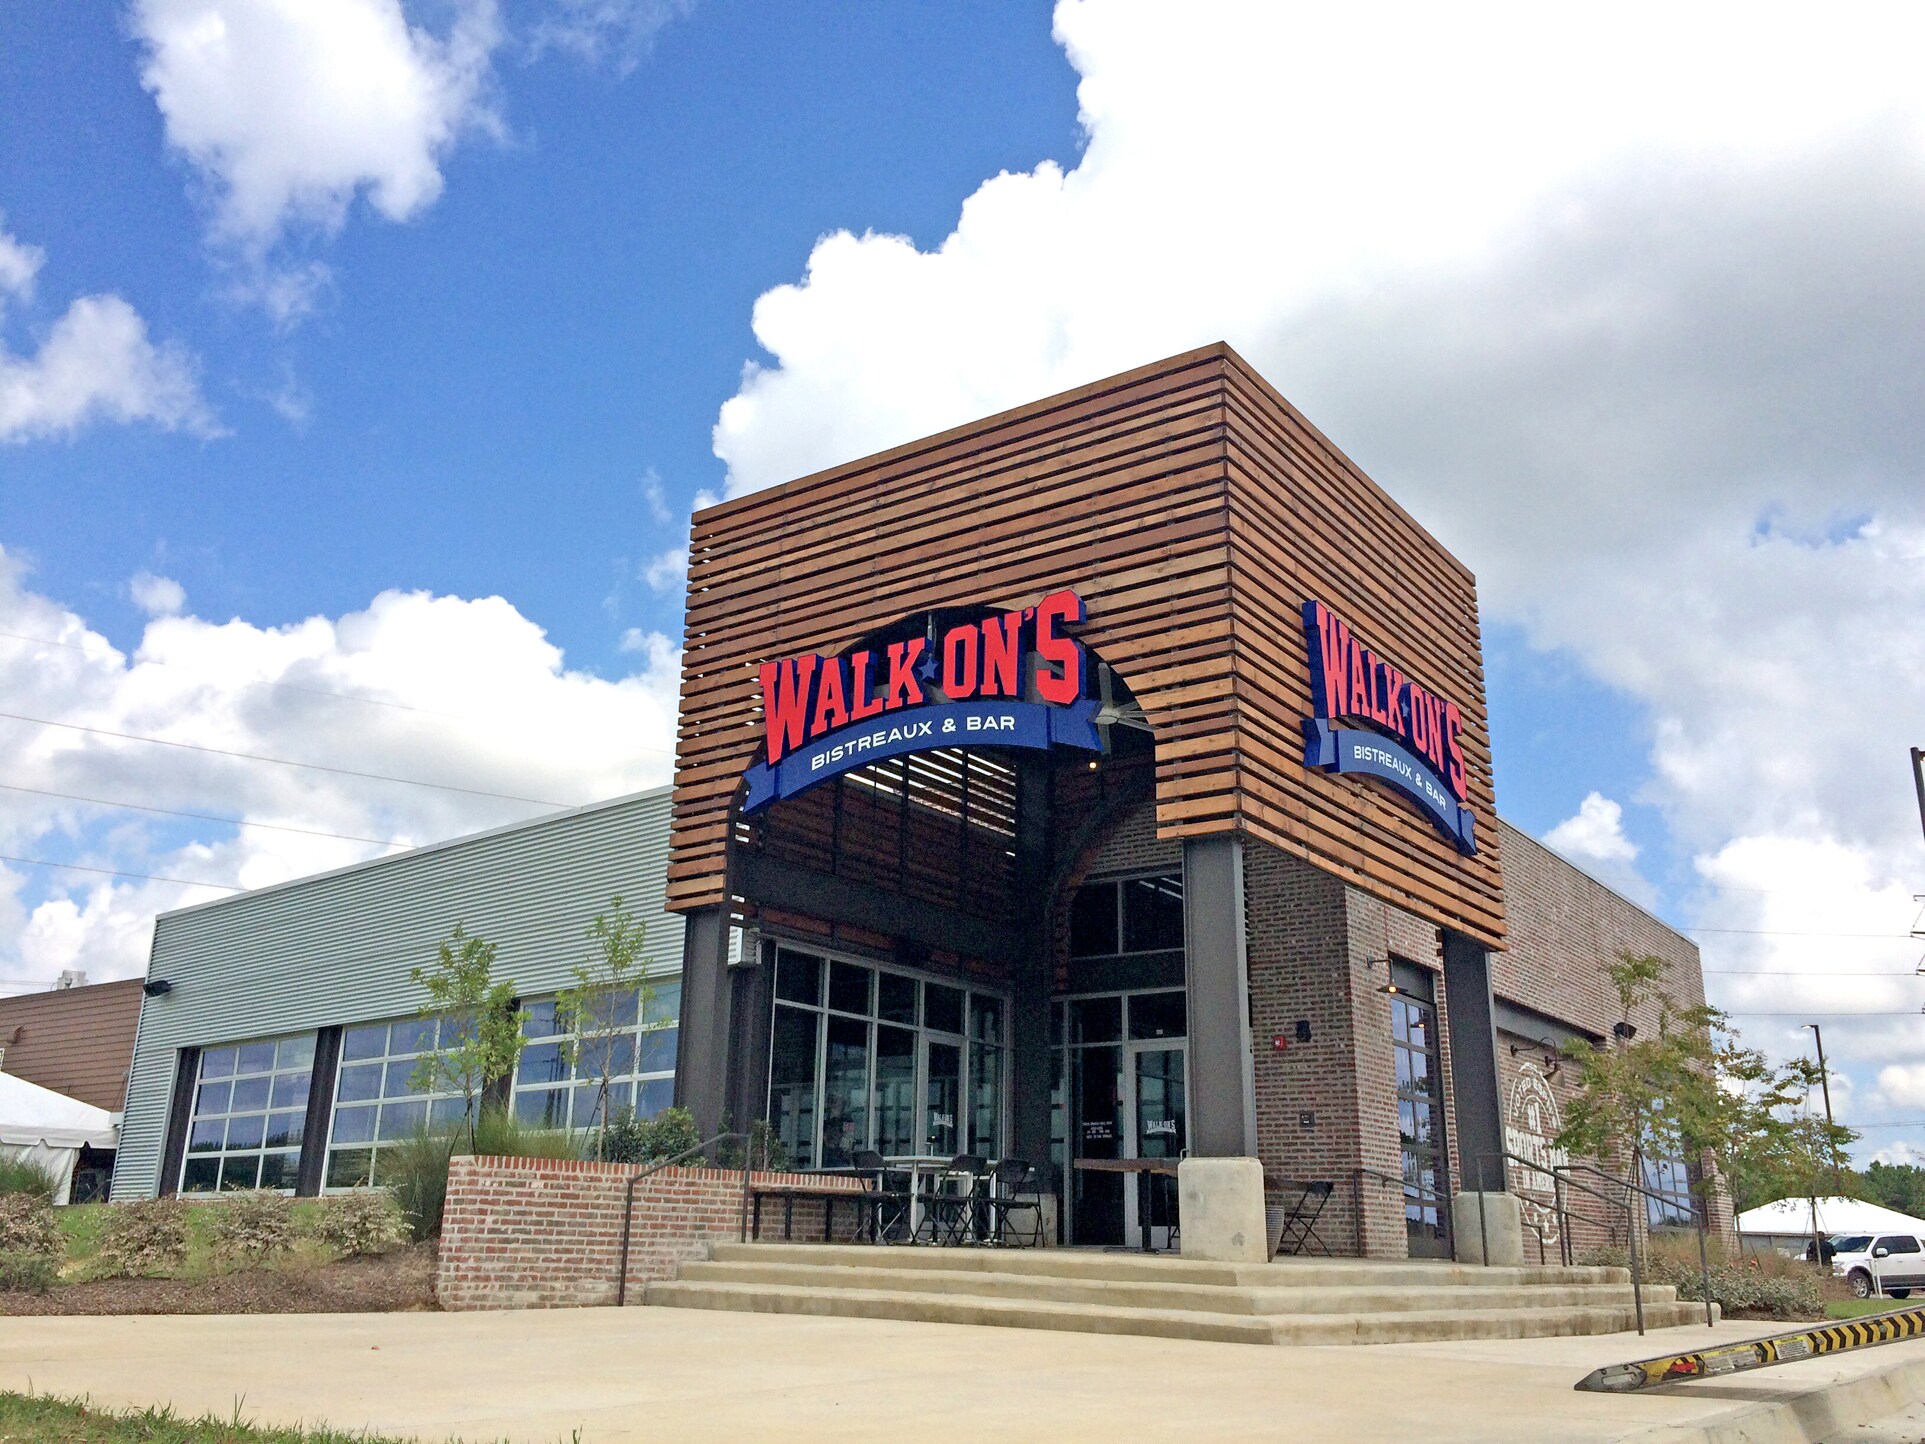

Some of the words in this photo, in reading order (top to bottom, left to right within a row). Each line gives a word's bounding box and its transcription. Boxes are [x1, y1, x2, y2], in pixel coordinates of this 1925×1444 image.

[759, 636, 926, 766] WALK
[943, 590, 1083, 705] ON'S
[1316, 601, 1405, 737] WALK
[1409, 682, 1467, 802] ON'S
[811, 721, 932, 770] BISTREAUX
[942, 718, 956, 733] &
[966, 716, 1016, 732] BAR
[1353, 745, 1413, 780] BISTREAUX
[1415, 773, 1423, 788] &
[1425, 780, 1447, 811] BAR
[1513, 1077, 1532, 1117] VOTED
[1527, 1102, 1542, 1134] #1
[1505, 1126, 1548, 1169] SPORTS
